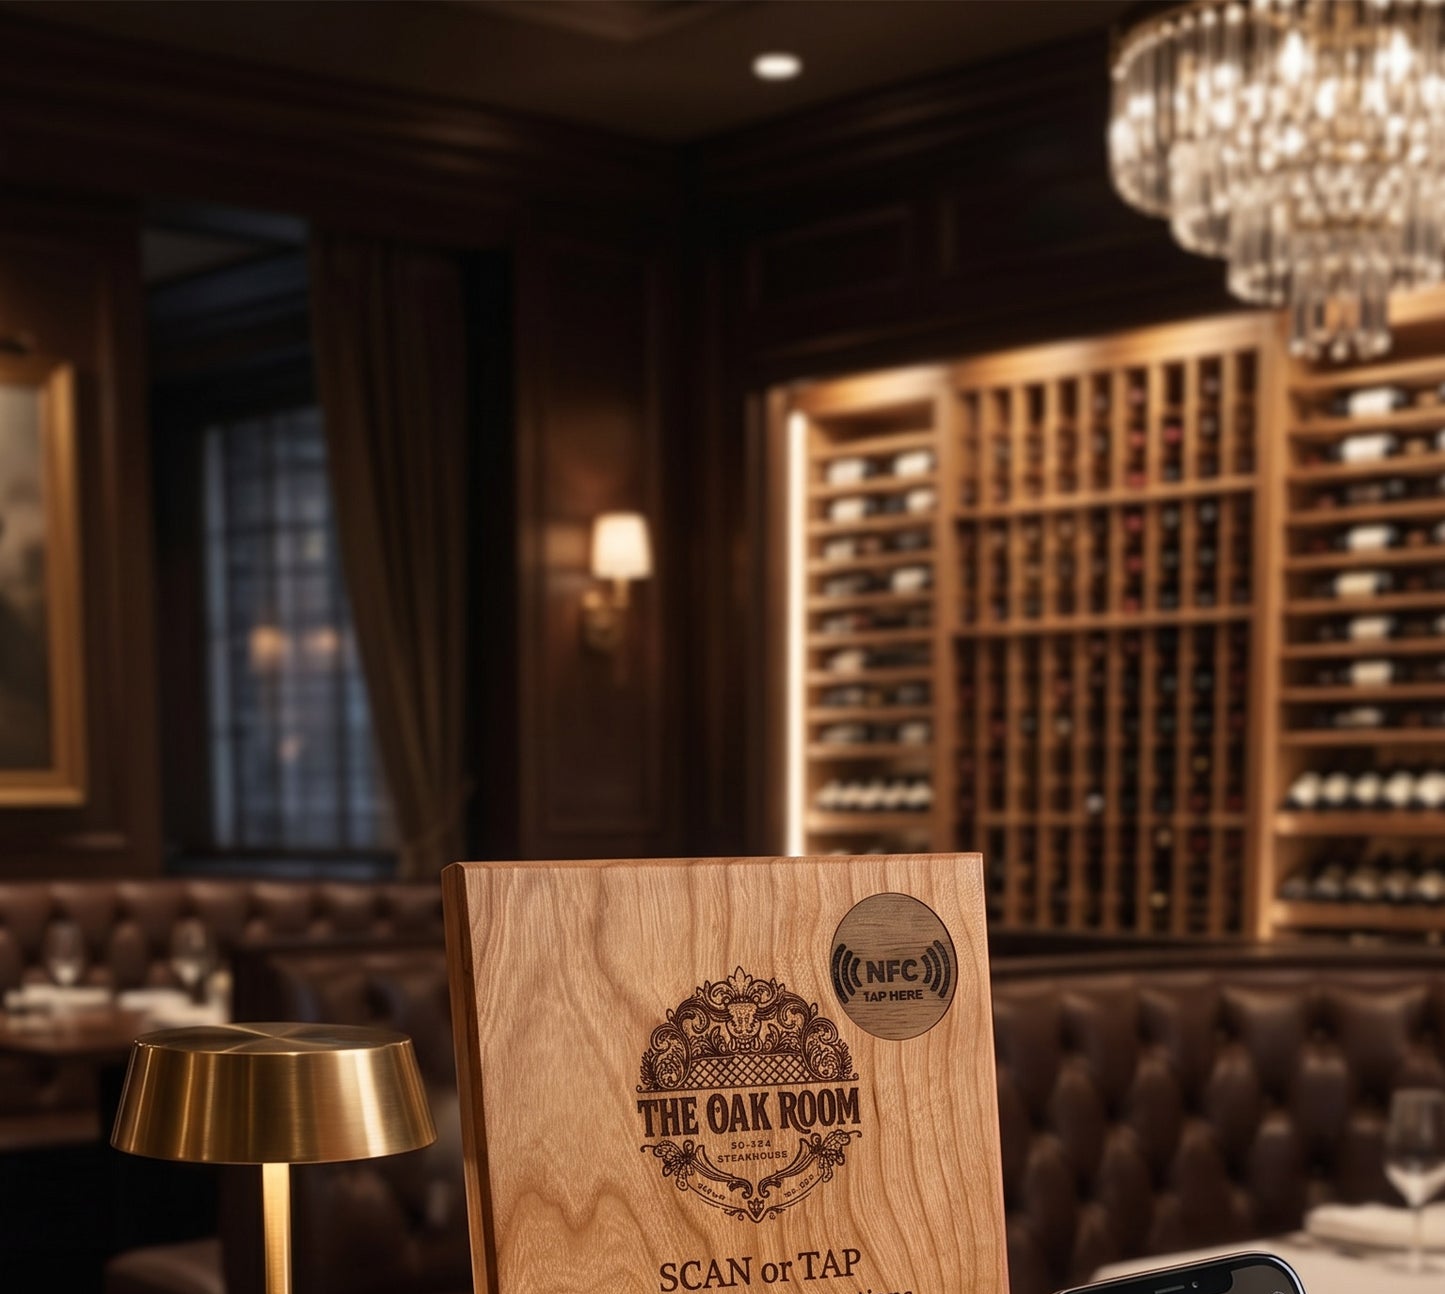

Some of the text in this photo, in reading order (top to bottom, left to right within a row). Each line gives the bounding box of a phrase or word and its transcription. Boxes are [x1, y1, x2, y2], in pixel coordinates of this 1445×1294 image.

[865, 959, 919, 984] NFC
[863, 989, 924, 1002] TAP HERE
[637, 1087, 861, 1138] THE OAK ROOM
[717, 1150, 788, 1163] STEAKHOUSE
[659, 1248, 861, 1292] SCAN or TAP
